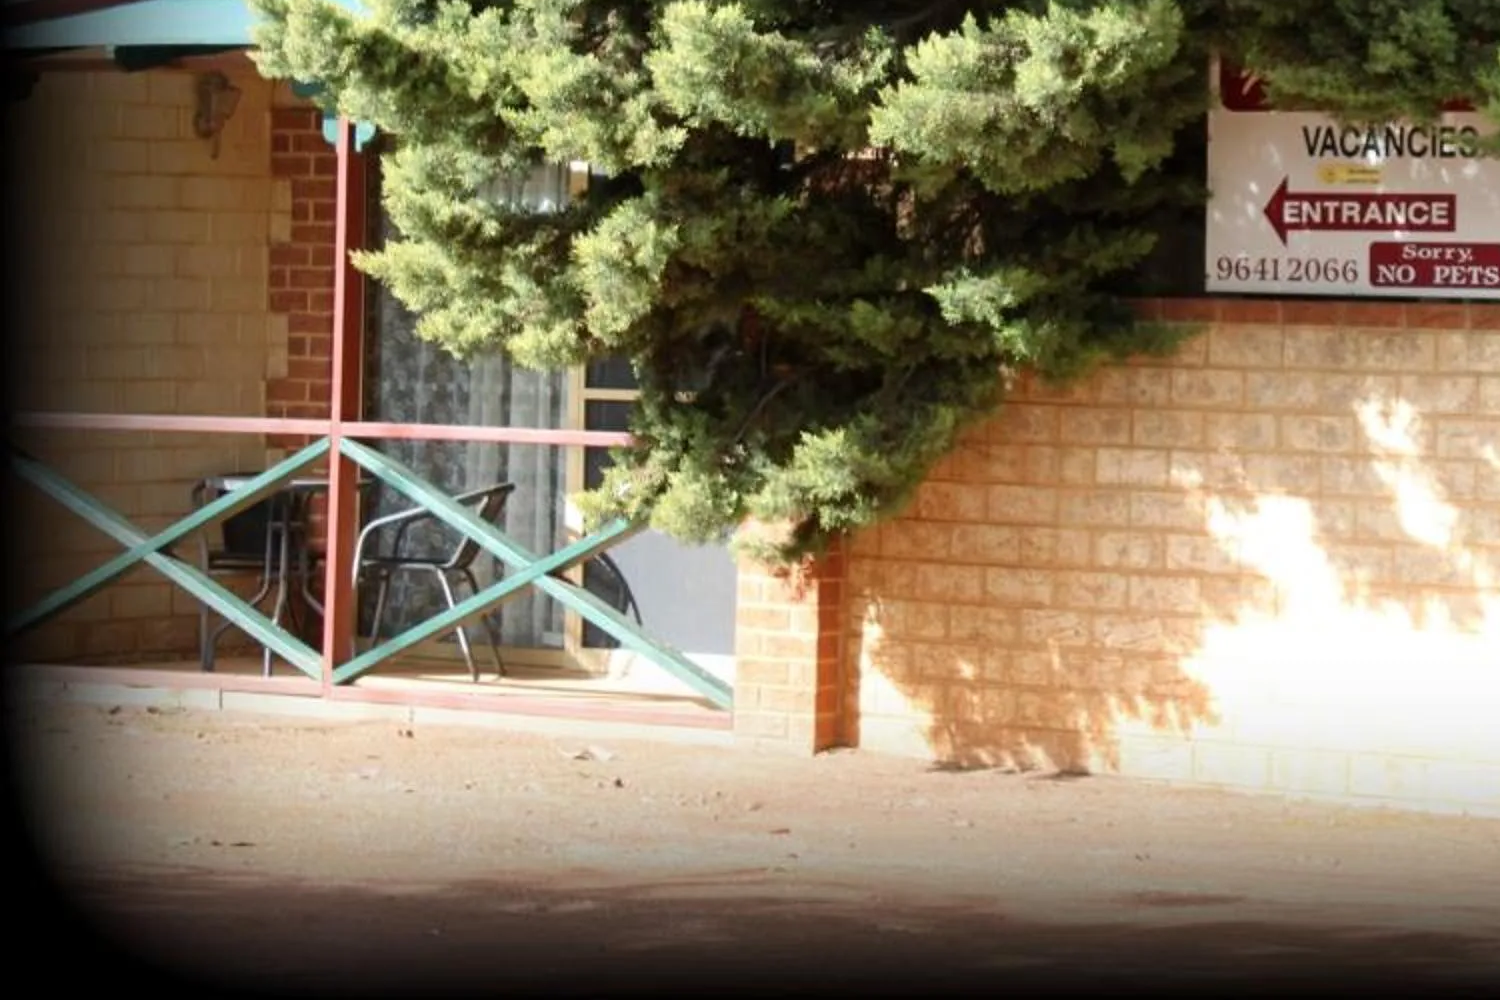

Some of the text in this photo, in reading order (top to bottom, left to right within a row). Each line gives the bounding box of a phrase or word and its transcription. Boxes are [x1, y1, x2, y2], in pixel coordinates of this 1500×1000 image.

[1282, 202, 1449, 225] ENTRANCE
[1376, 264, 1500, 286] NO PETS
